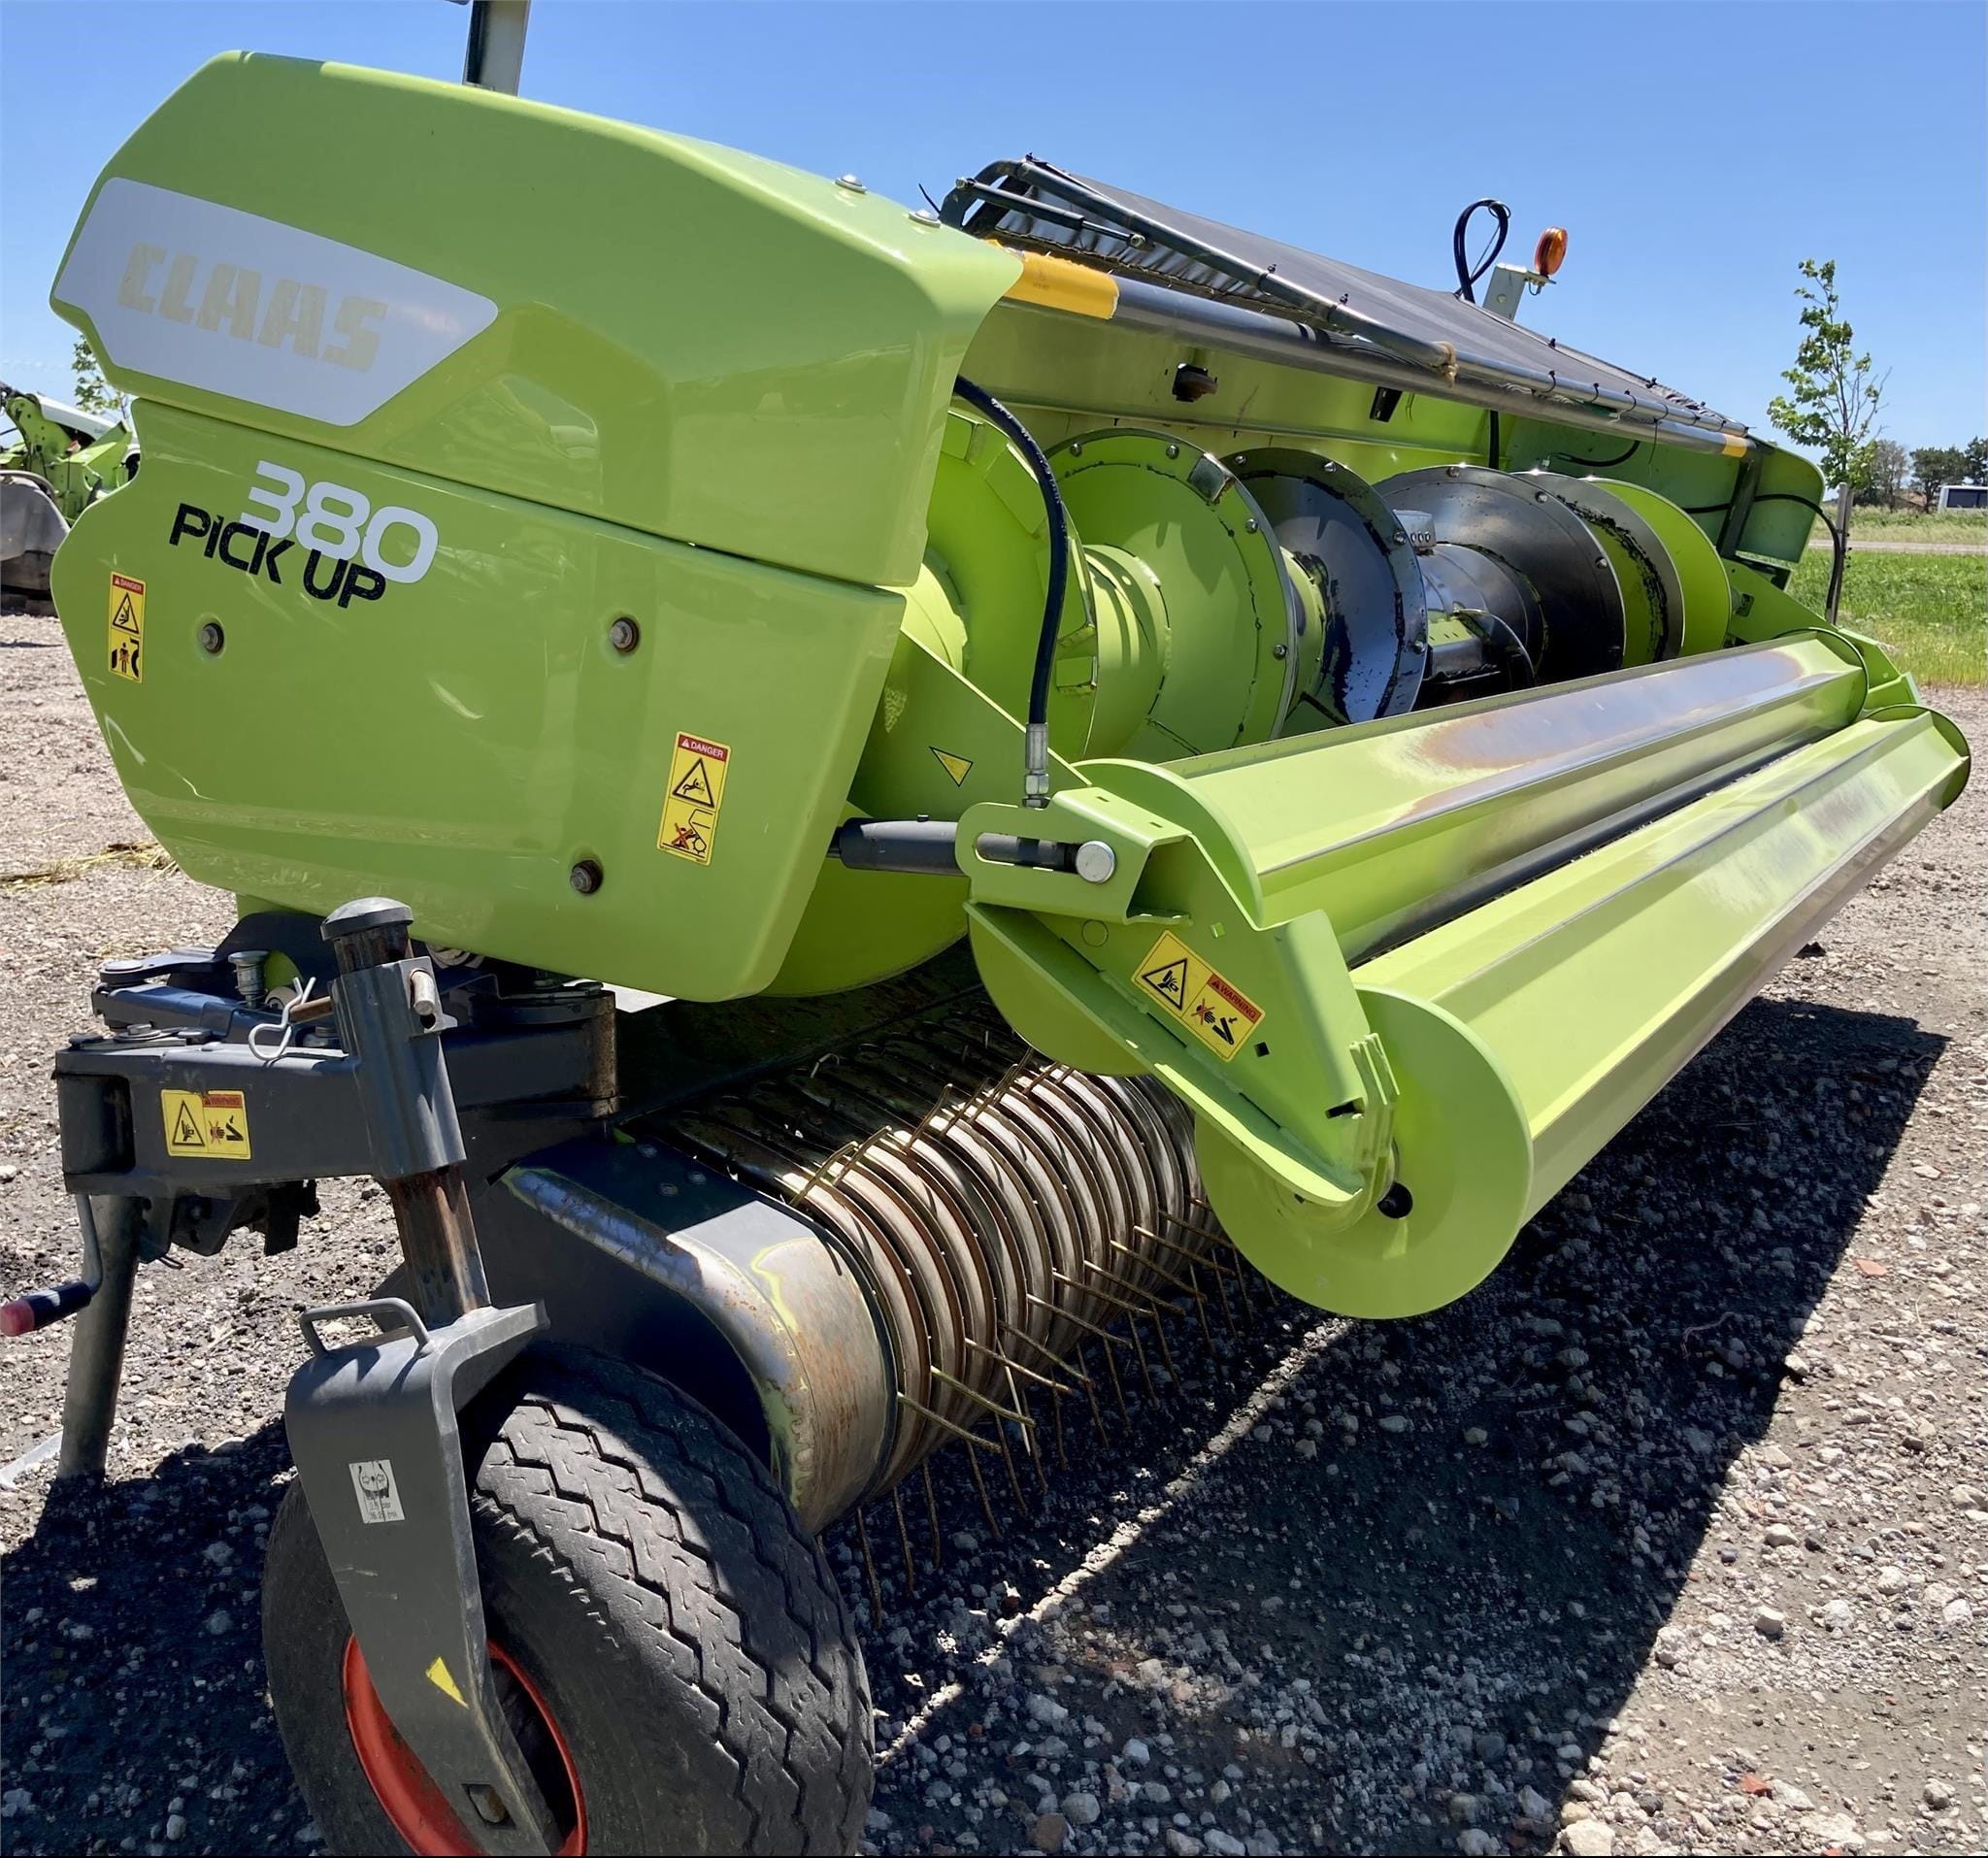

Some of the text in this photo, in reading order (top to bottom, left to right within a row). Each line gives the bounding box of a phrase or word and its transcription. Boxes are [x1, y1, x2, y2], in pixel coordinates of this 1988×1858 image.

[117, 242, 387, 372] CLAAS
[239, 460, 438, 583] 380
[303, 548, 386, 609] UP
[690, 741, 724, 758] DANGER
[1220, 983, 1256, 1019] WARNING
